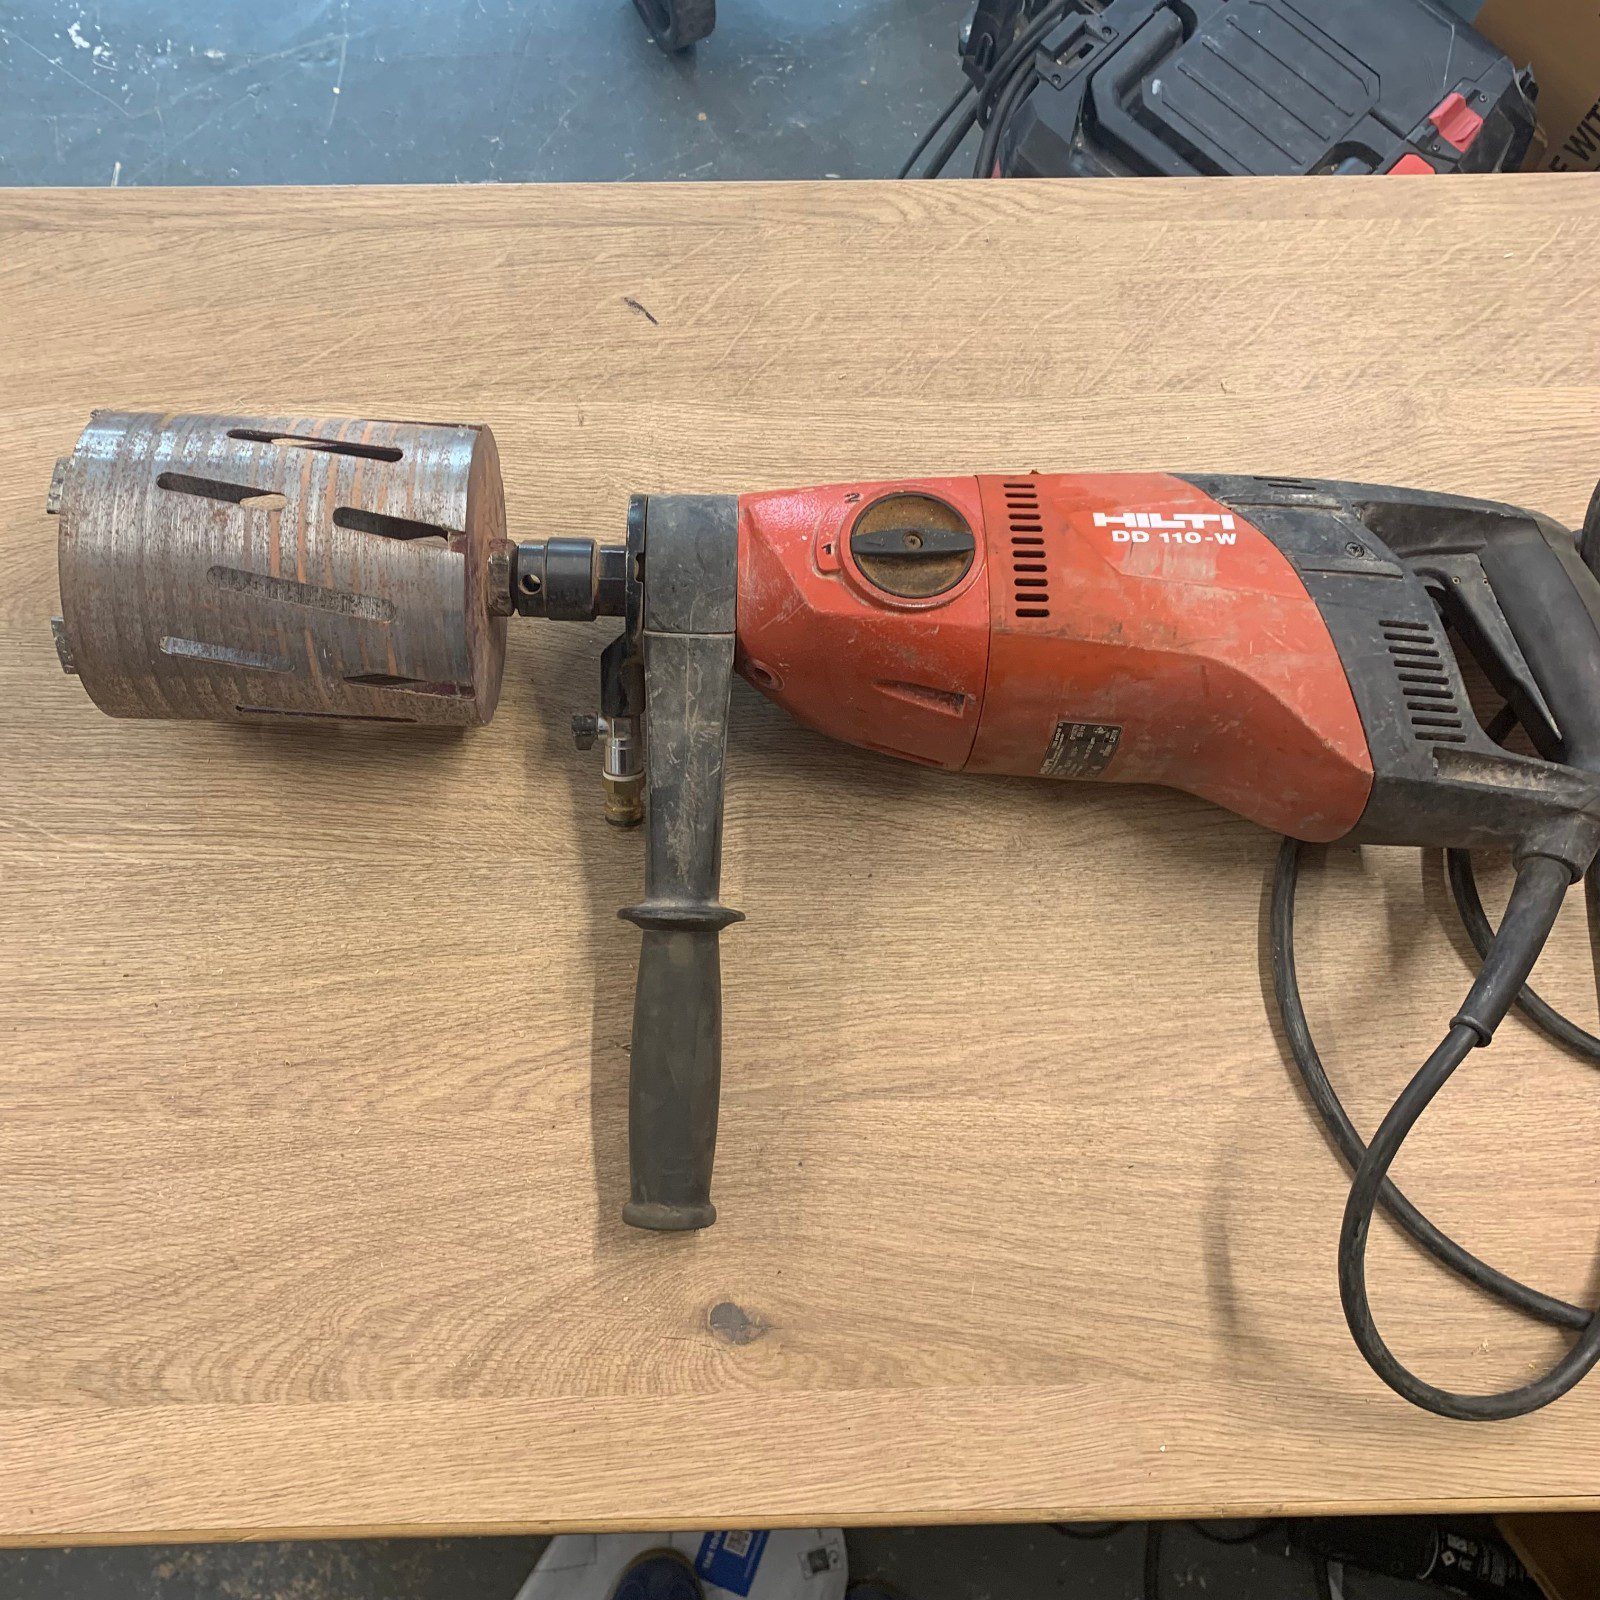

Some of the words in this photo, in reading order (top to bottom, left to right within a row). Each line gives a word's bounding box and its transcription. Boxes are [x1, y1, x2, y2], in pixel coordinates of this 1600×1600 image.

[1564, 96, 1600, 161] WIT
[844, 492, 861, 503] 2
[1092, 512, 1236, 530] HILTI
[1112, 530, 1150, 543] DD
[1160, 531, 1236, 545] 110-W
[822, 543, 832, 555] 1
